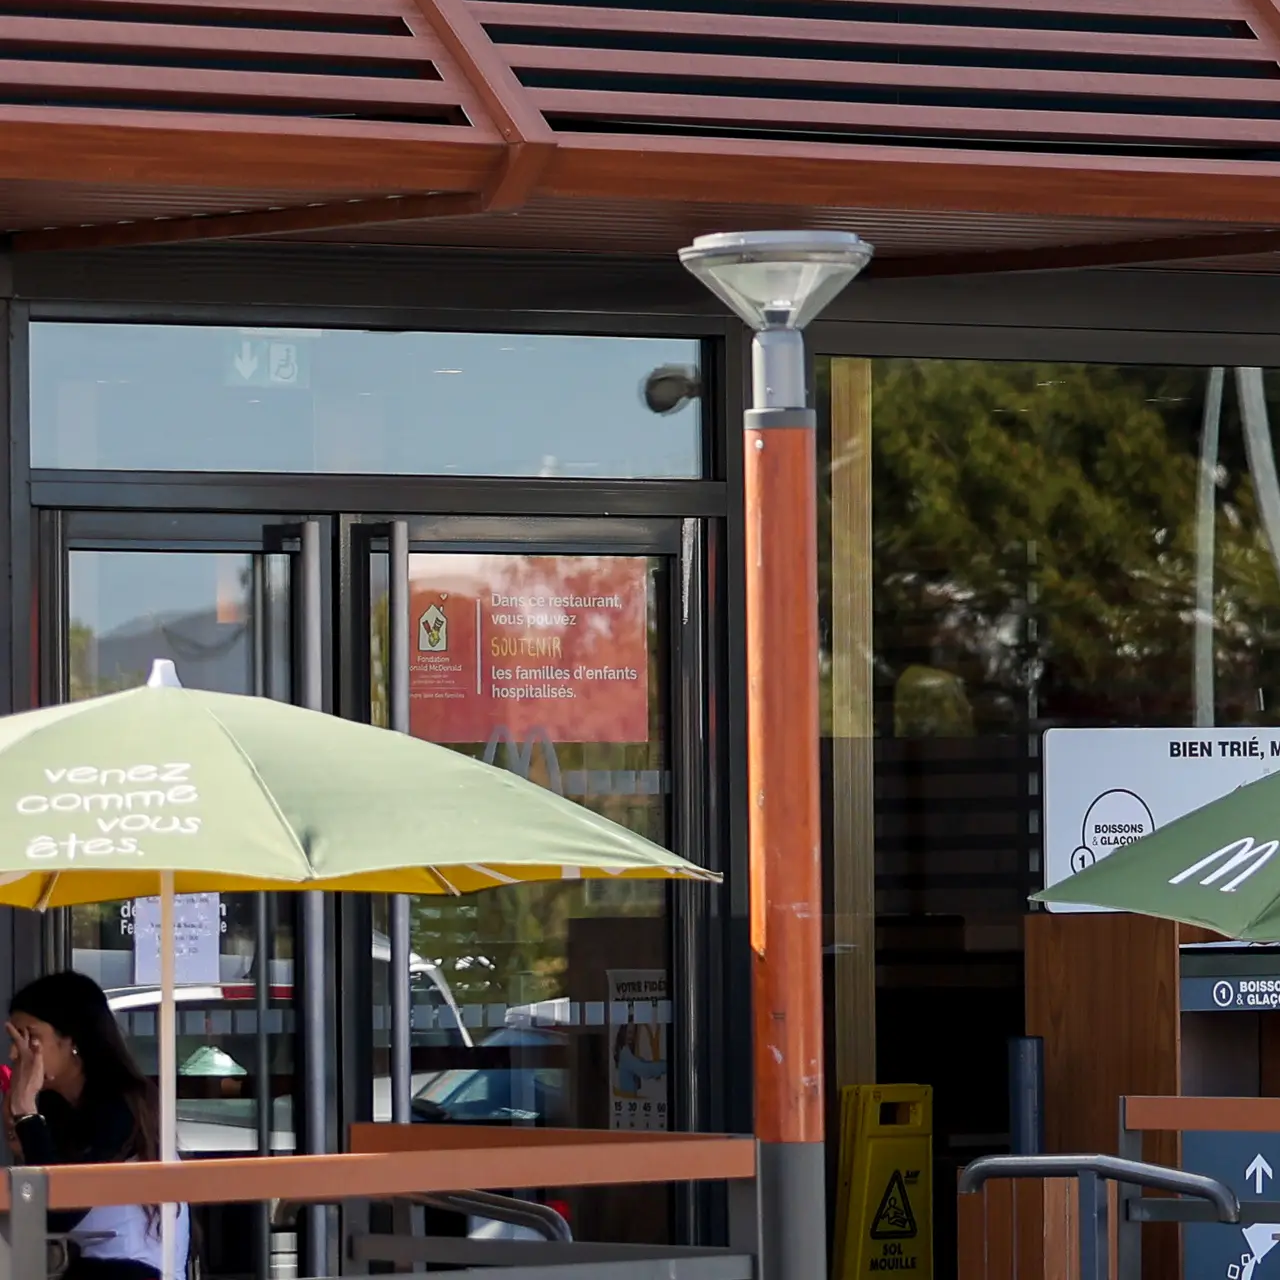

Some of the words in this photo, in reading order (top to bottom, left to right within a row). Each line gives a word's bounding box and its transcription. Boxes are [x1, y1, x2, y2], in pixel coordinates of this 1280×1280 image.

[491, 593, 525, 608] Dans
[528, 596, 545, 608] ce
[549, 595, 623, 609] restaurant,
[491, 615, 524, 626] vous
[527, 615, 577, 628] pouvez
[491, 636, 562, 659] SOUTENIR
[491, 666, 512, 680] les
[515, 666, 570, 680] familles
[574, 666, 637, 680] d'enfants
[491, 684, 577, 701] hospitalisés.
[1169, 741, 1213, 758] BIEN
[1217, 736, 1265, 760] TRIÉ,
[44, 762, 192, 787] venez
[16, 785, 199, 813] comme
[96, 814, 202, 834] vous
[1094, 823, 1144, 834] BOISSONS
[26, 832, 145, 860] êtes.
[615, 980, 642, 994] VOTRE
[1236, 993, 1244, 1005] &
[614, 1101, 623, 1112] 15
[628, 1101, 637, 1112] 30
[643, 1101, 652, 1112] 45
[883, 1243, 903, 1257] SOL
